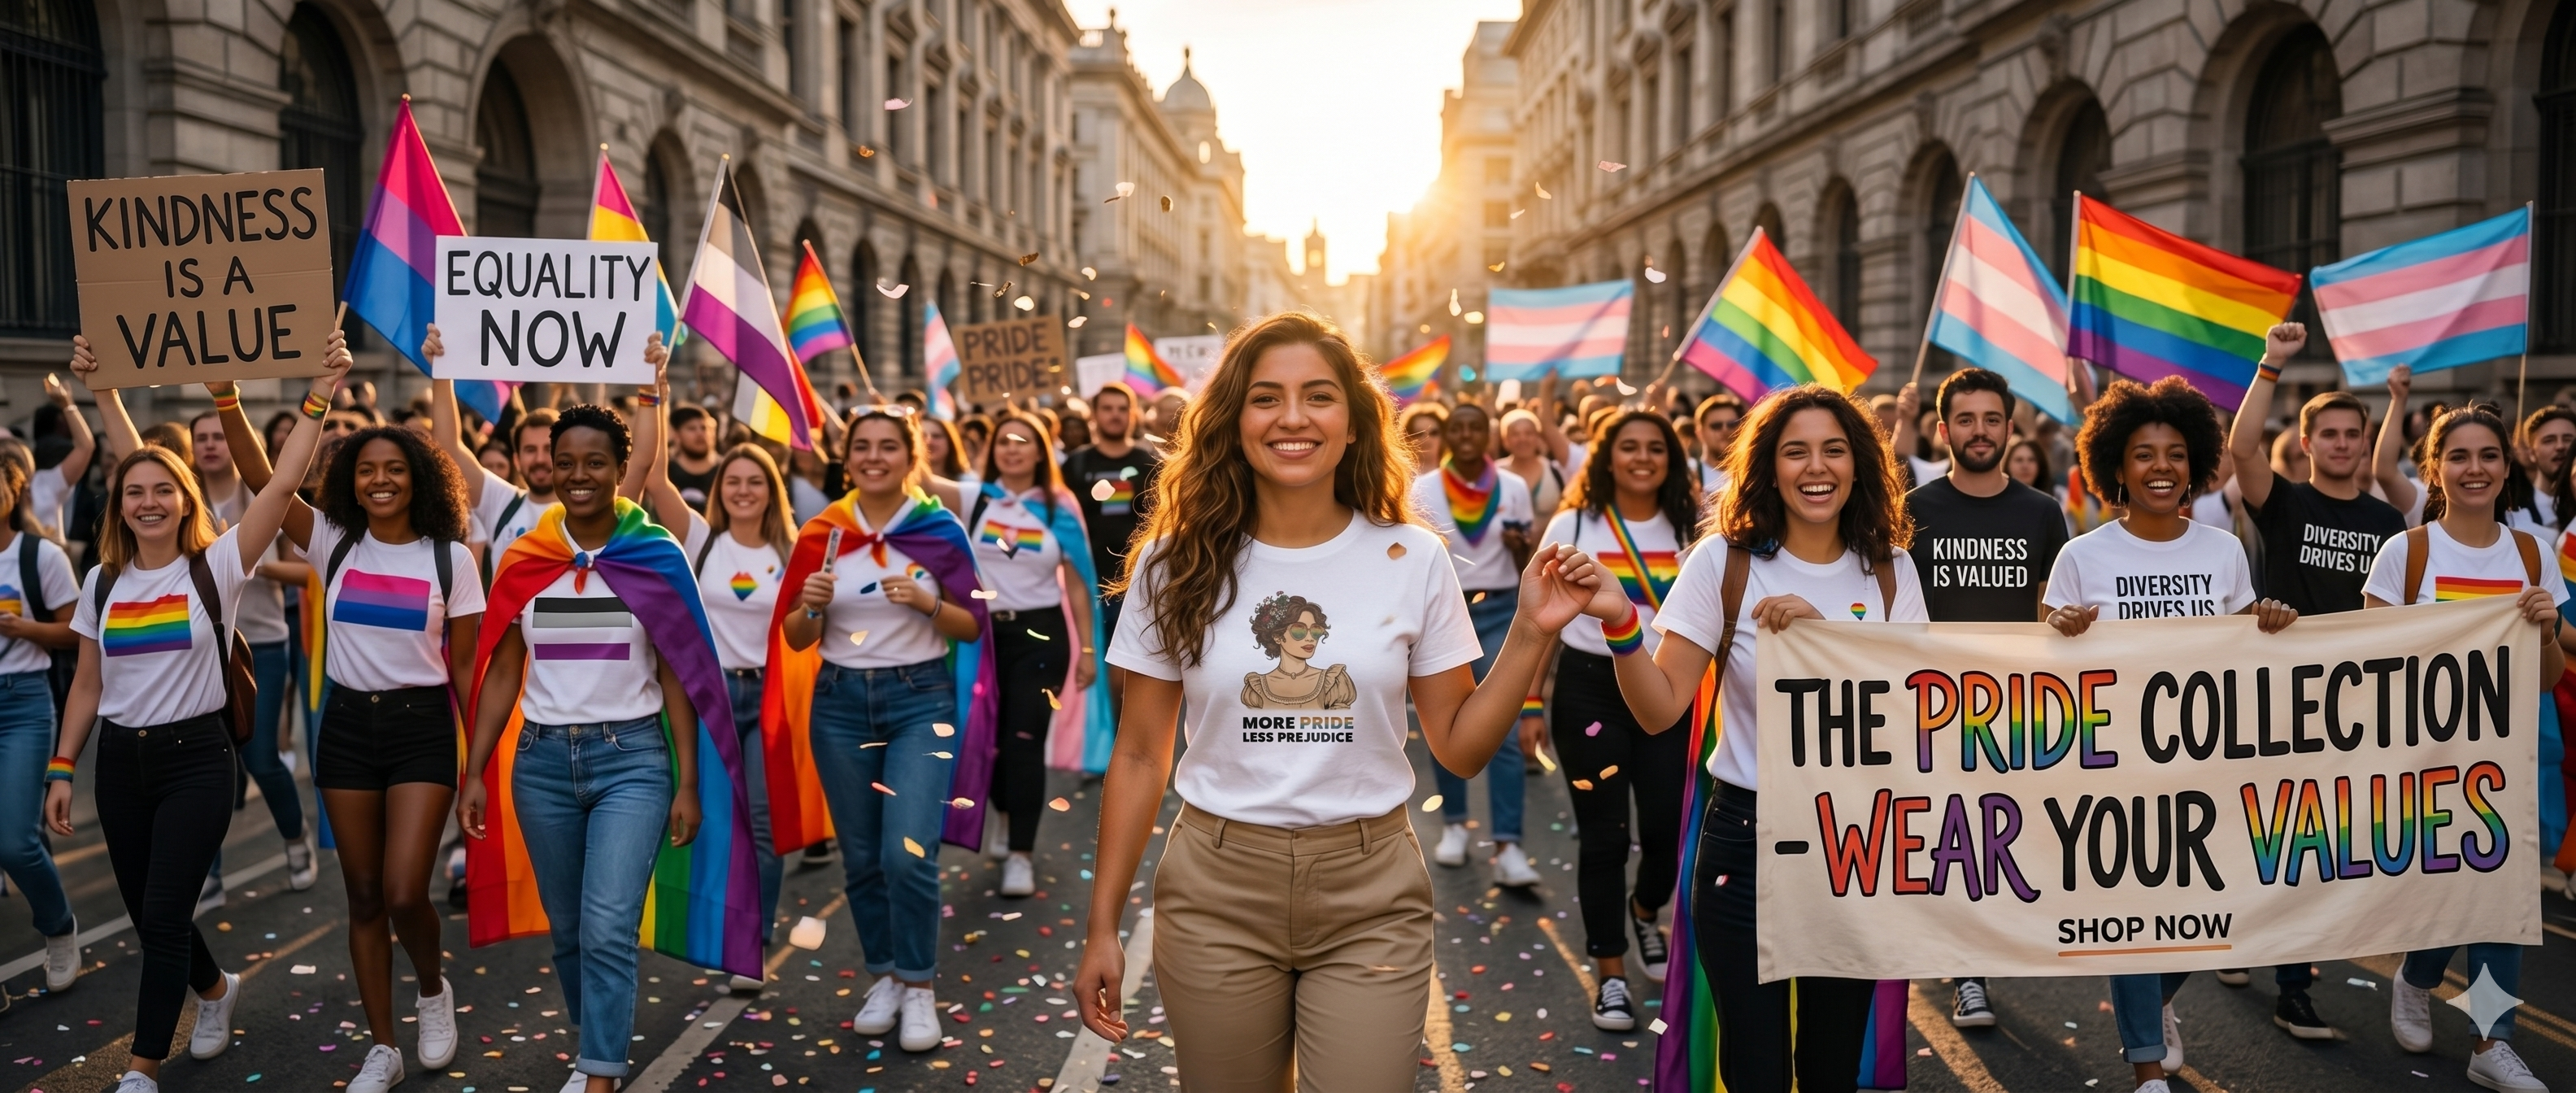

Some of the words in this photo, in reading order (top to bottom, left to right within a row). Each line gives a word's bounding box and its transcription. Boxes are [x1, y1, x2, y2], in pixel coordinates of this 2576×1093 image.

[85, 186, 317, 252] KINDNESS
[164, 258, 204, 298] IS
[223, 256, 255, 296] A
[447, 250, 651, 302] EQUALITY
[115, 303, 302, 369] VALUE
[481, 309, 627, 368] NOW
[963, 322, 1049, 360] PRIDE
[1933, 538, 2028, 560] KINDNESS
[2304, 523, 2381, 553] DIVERSITY
[2300, 544, 2356, 573] DRIVES
[1934, 564, 1951, 587] IS
[1956, 564, 2028, 588] VALUED
[2116, 573, 2213, 598] DIVERSITY
[2118, 599, 2186, 620] DRIVES
[2191, 599, 2216, 616] US
[1242, 716, 1295, 729] MORE
[1299, 716, 1354, 729] PRIDE
[1774, 677, 1892, 768] THE
[1904, 668, 2119, 774] PRIDE
[2140, 645, 2511, 764] COLLECTION
[1242, 732, 1274, 743] LESS
[1277, 732, 1354, 743] PREJUDICE
[2047, 790, 2226, 892] YOUR
[2239, 760, 2511, 886] VALUES
[2058, 917, 2145, 944] SHOP
[2155, 912, 2233, 941] NOW
